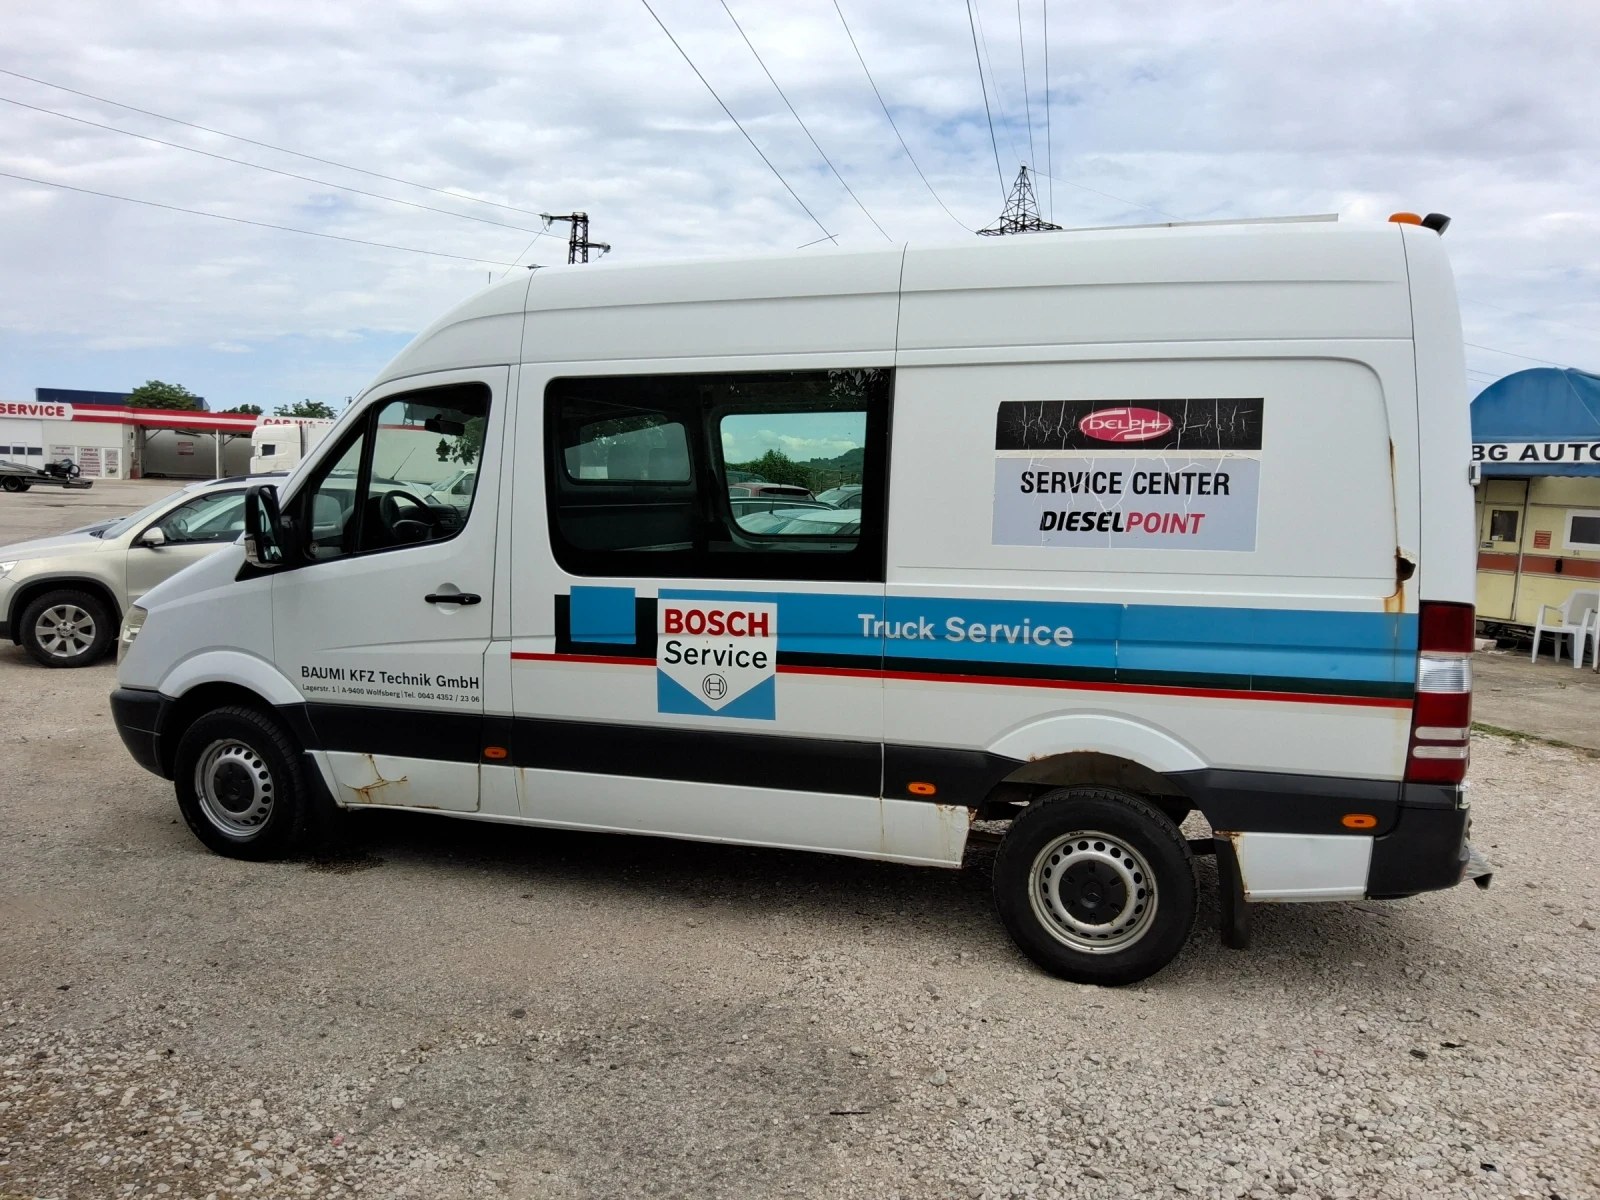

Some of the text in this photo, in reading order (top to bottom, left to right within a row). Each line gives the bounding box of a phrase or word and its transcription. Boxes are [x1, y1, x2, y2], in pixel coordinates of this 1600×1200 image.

[0, 403, 65, 417] SERVICE
[1089, 419, 1160, 430] DELPHI
[1472, 444, 1509, 461] BG
[1020, 471, 1230, 495] SERVICE CENTER
[665, 608, 769, 637] BOSCH
[857, 613, 1074, 647] Truck Service
[664, 640, 767, 669] Service
[301, 665, 479, 690] BAUMI KFZ Technik GmbH
[302, 683, 331, 693] Lagerstr.
[342, 687, 365, 695] A-9400
[366, 688, 400, 699] Wolfsberg
[436, 693, 453, 702] 4352
